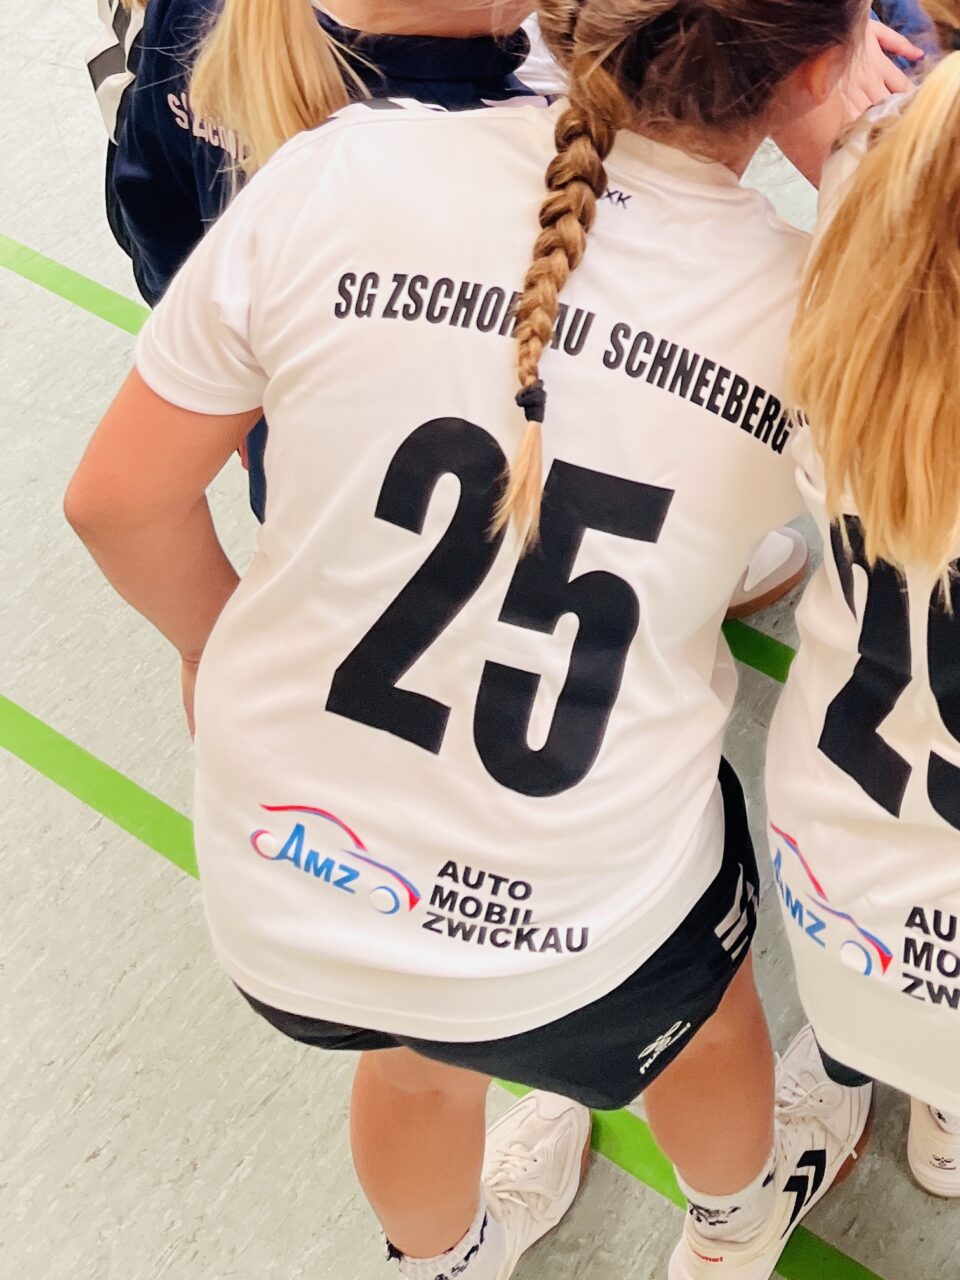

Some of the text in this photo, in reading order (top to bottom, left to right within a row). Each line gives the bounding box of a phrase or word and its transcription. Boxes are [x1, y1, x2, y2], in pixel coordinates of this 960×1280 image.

[334, 272, 794, 455] SG ZSCHOAU SCHNEEBERG
[325, 417, 675, 798] 25
[437, 860, 533, 901] AUTO
[429, 884, 538, 926] MOBIL
[422, 911, 589, 953] ZWICKAU
